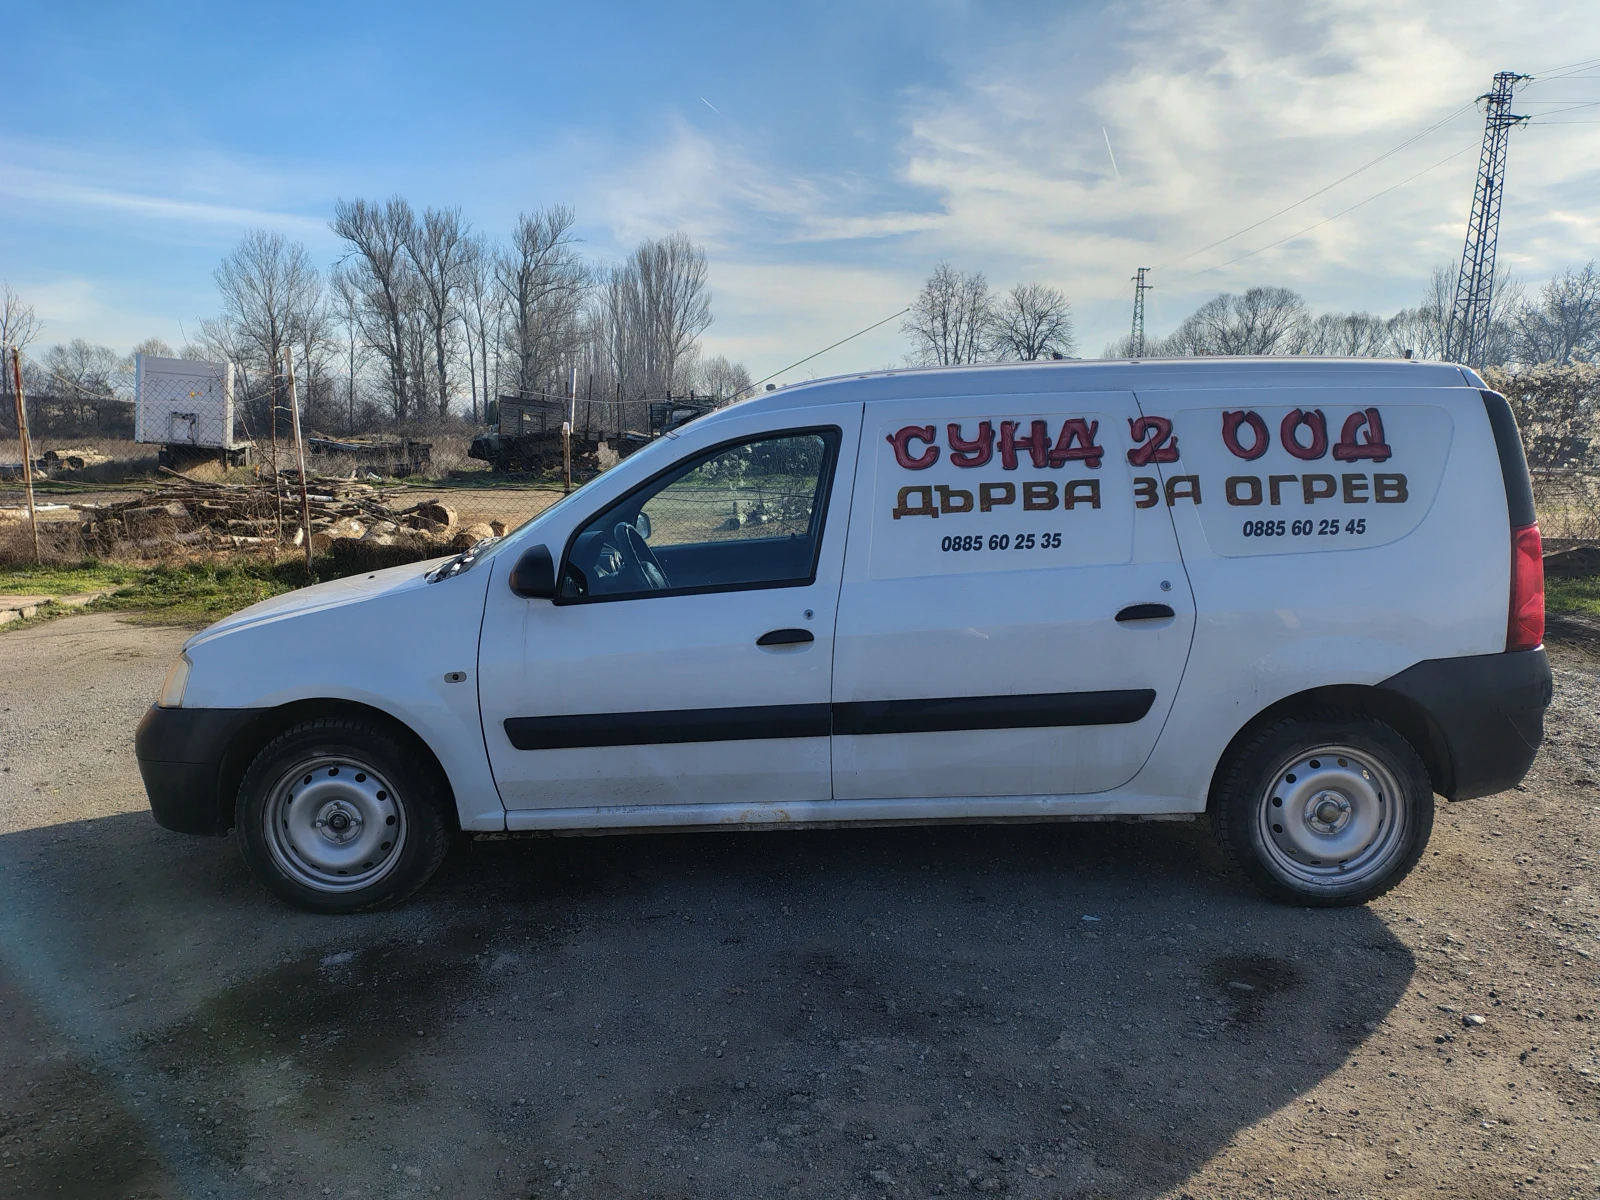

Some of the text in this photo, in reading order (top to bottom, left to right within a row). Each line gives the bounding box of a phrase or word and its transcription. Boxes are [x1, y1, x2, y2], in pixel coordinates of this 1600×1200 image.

[886, 408, 1392, 471] СУНД 2 ООД
[892, 473, 1409, 520] ДЪРВА ЗА ОГРЕВ
[941, 532, 1062, 552] 0885 60 25 35
[1242, 518, 1366, 537] 0885 60 25 45
